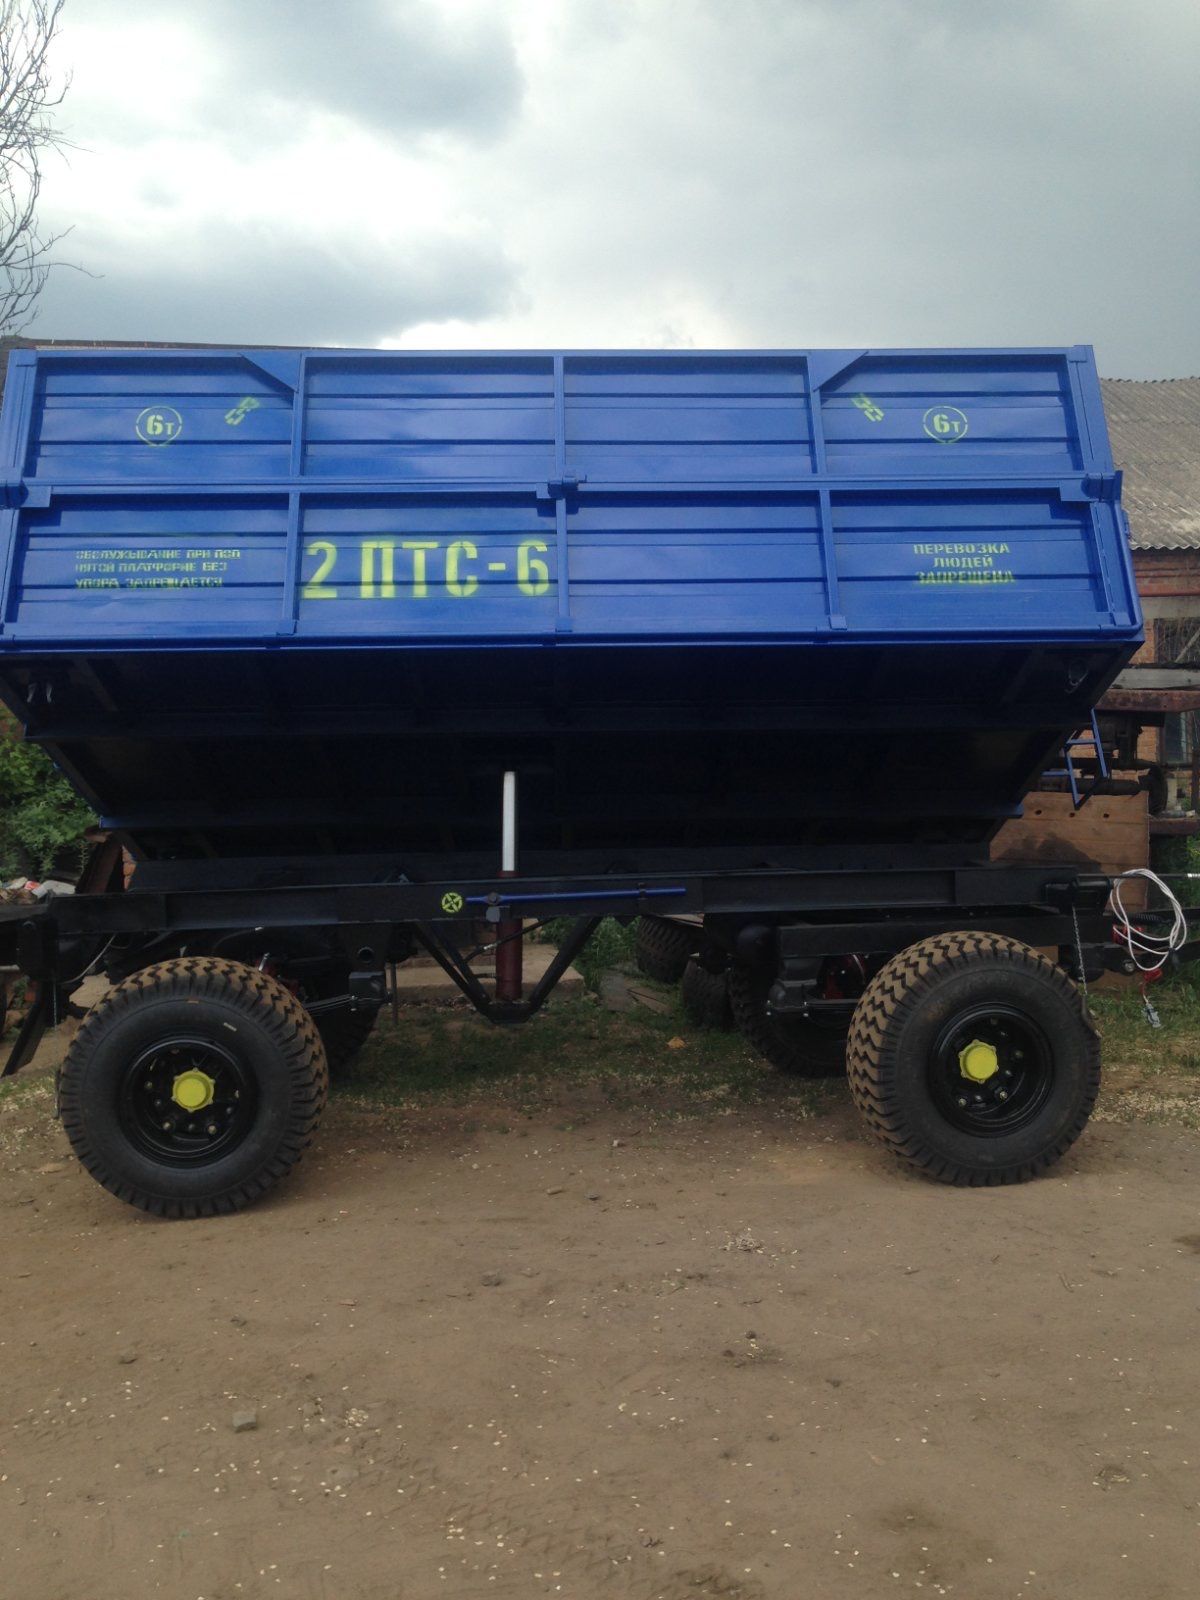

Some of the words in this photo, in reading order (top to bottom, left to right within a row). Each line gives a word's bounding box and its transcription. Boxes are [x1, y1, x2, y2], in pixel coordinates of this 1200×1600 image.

[913, 543, 1010, 554] ПЕРЕВОЗКА
[933, 554, 993, 569] ЛЮДЕЙ
[303, 541, 338, 599] 2
[916, 570, 1016, 584] ЗАПРЕЩЕНА
